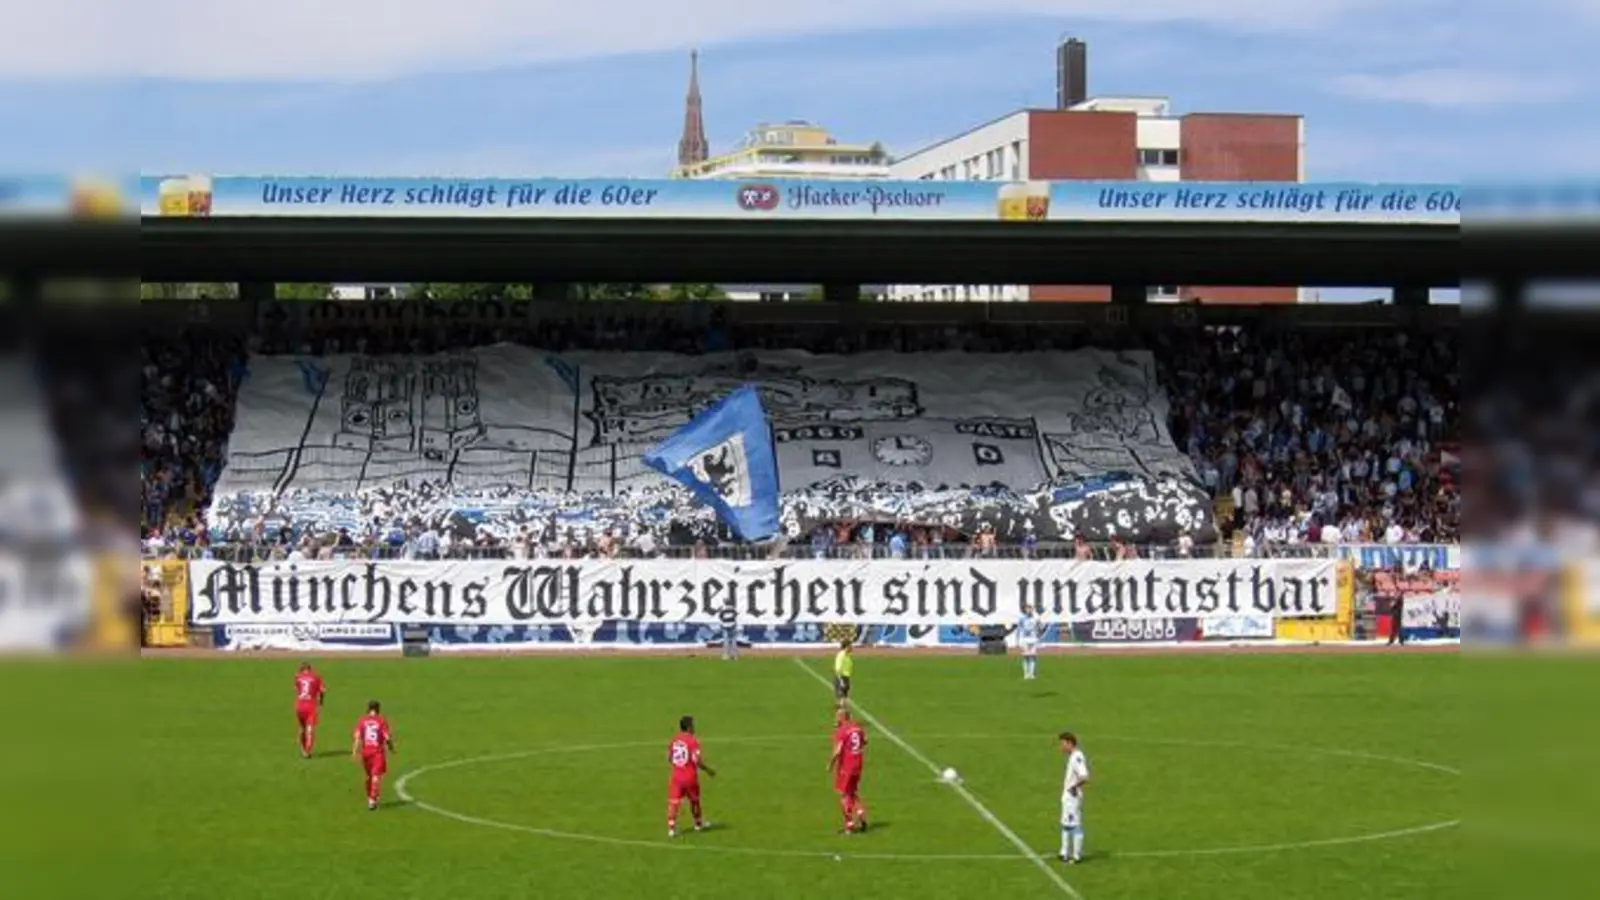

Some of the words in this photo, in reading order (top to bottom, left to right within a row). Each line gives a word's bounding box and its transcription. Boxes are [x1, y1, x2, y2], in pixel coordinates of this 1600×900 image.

[262, 183, 332, 204] Unser
[340, 183, 395, 204] Herz
[404, 184, 497, 208] schlägt
[506, 184, 547, 208] für
[554, 184, 592, 205] die
[601, 185, 658, 205] 60er
[787, 184, 945, 213] Hacker-Pschorr
[1098, 187, 1167, 209] Unser
[1174, 188, 1227, 209] Herz
[1236, 187, 1325, 212] schlägt
[1334, 188, 1374, 213] für
[1380, 189, 1418, 211] die
[198, 562, 488, 625] Münchens
[503, 565, 865, 622] Wahrzeichen
[882, 564, 997, 617] sind
[1017, 564, 1330, 620] unantastbar
